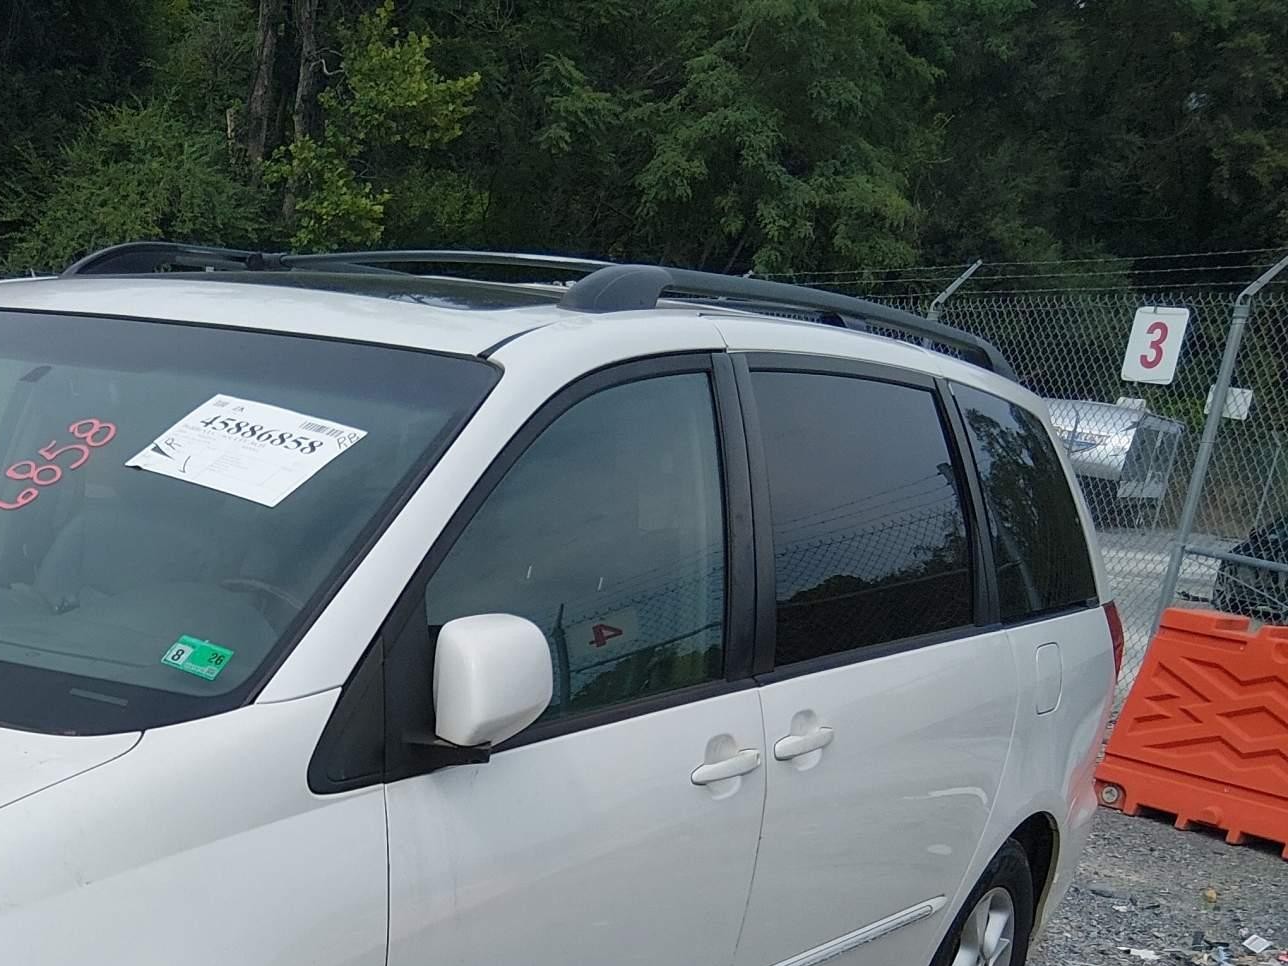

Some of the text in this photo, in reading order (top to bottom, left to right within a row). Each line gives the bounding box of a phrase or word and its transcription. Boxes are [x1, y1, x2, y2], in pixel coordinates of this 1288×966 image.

[1139, 321, 1169, 370] 3
[200, 414, 324, 456] 45886858
[171, 648, 225, 666] 8 26
